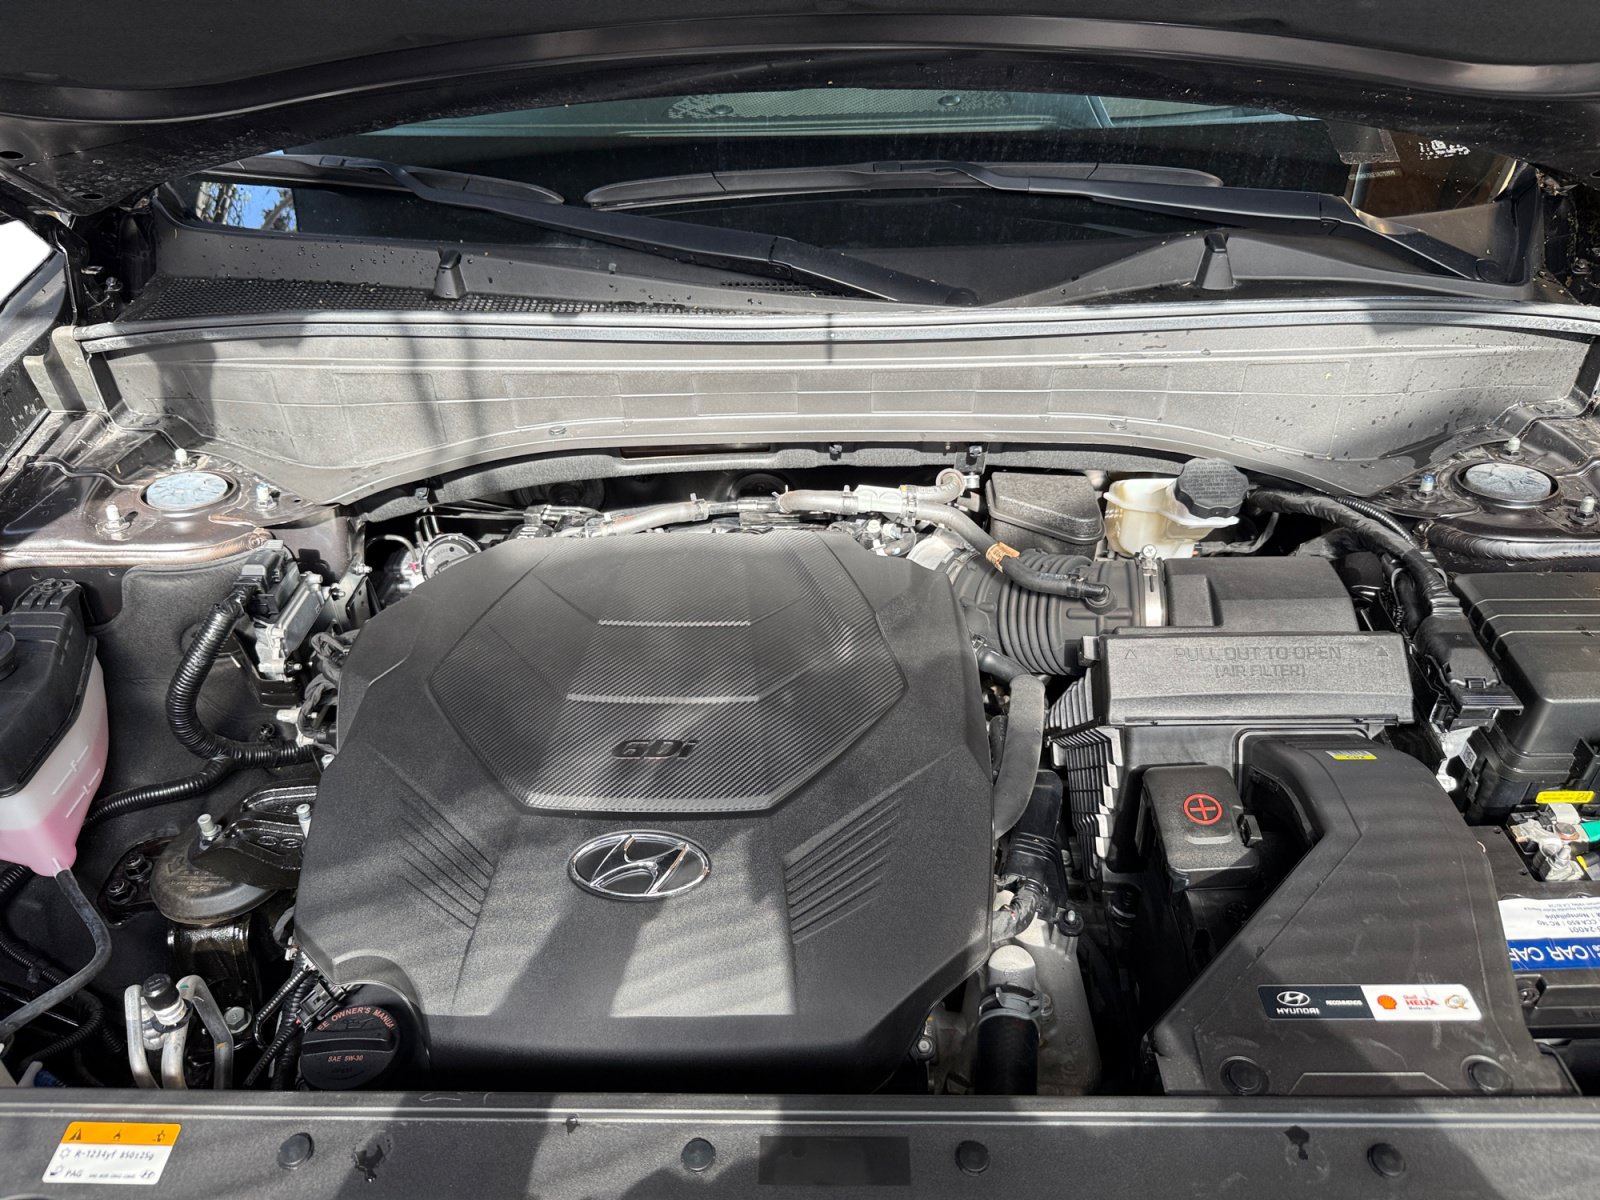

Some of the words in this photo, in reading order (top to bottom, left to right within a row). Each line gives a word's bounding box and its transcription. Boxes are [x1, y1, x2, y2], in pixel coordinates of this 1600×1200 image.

[1175, 647, 1221, 661] PULL
[1224, 646, 1261, 660] OUT
[1267, 646, 1288, 660] TO
[1293, 646, 1342, 660] OPEN
[1546, 945, 1589, 961] CAR
[1405, 998, 1440, 1006] HELIX
[1276, 1007, 1320, 1015] HYUNDAI
[331, 1007, 371, 1022] OWNER'S
[373, 1009, 395, 1029] MANUA
[75, 1149, 117, 1161] R-1234yf
[65, 1170, 83, 1178] PAG
